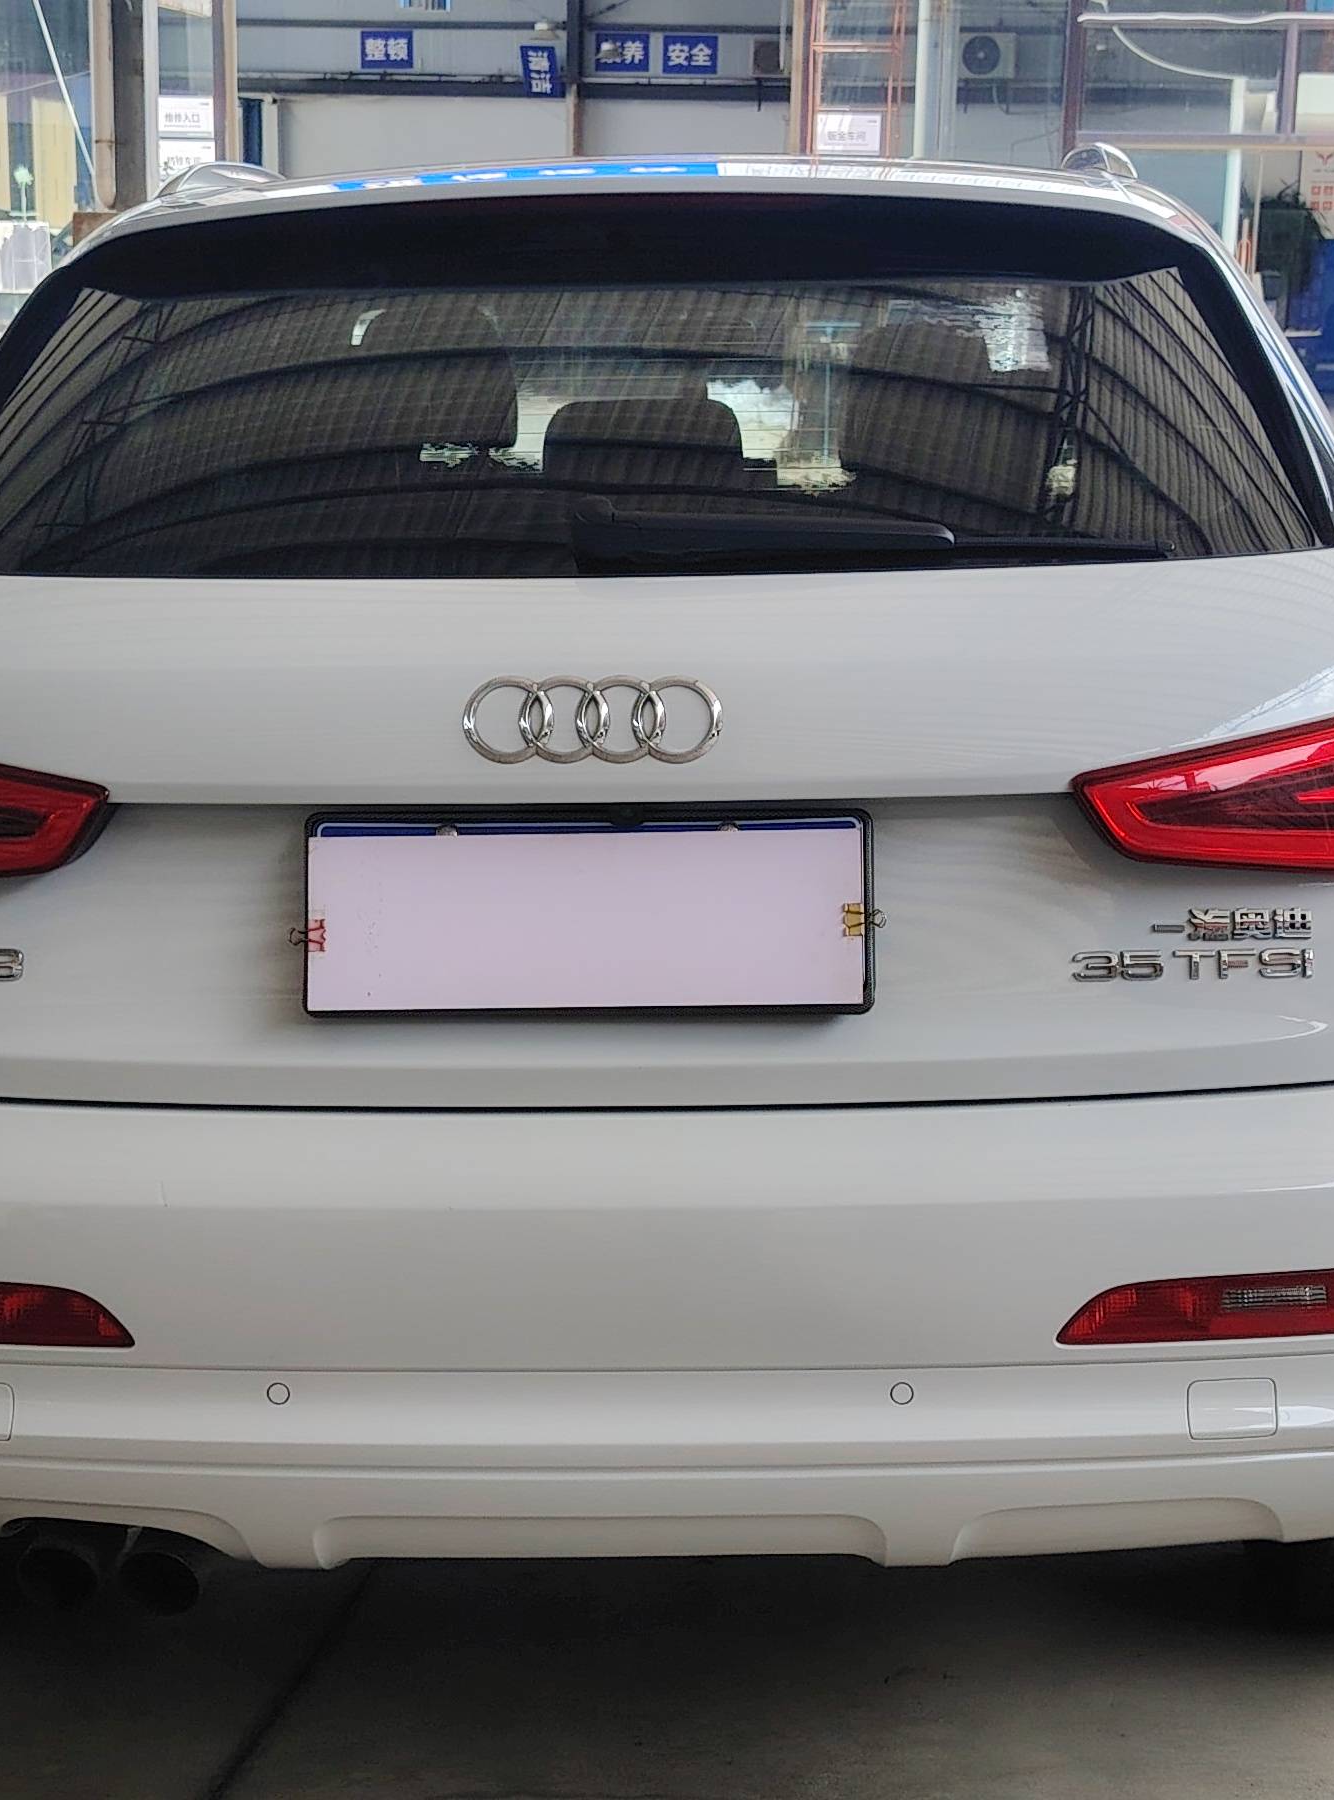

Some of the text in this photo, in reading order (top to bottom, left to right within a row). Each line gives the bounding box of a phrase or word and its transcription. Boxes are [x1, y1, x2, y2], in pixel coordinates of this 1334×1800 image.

[365, 37, 409, 61] 整顿
[667, 43, 713, 67] 安全
[1150, 907, 1313, 942] 一汽奥迪
